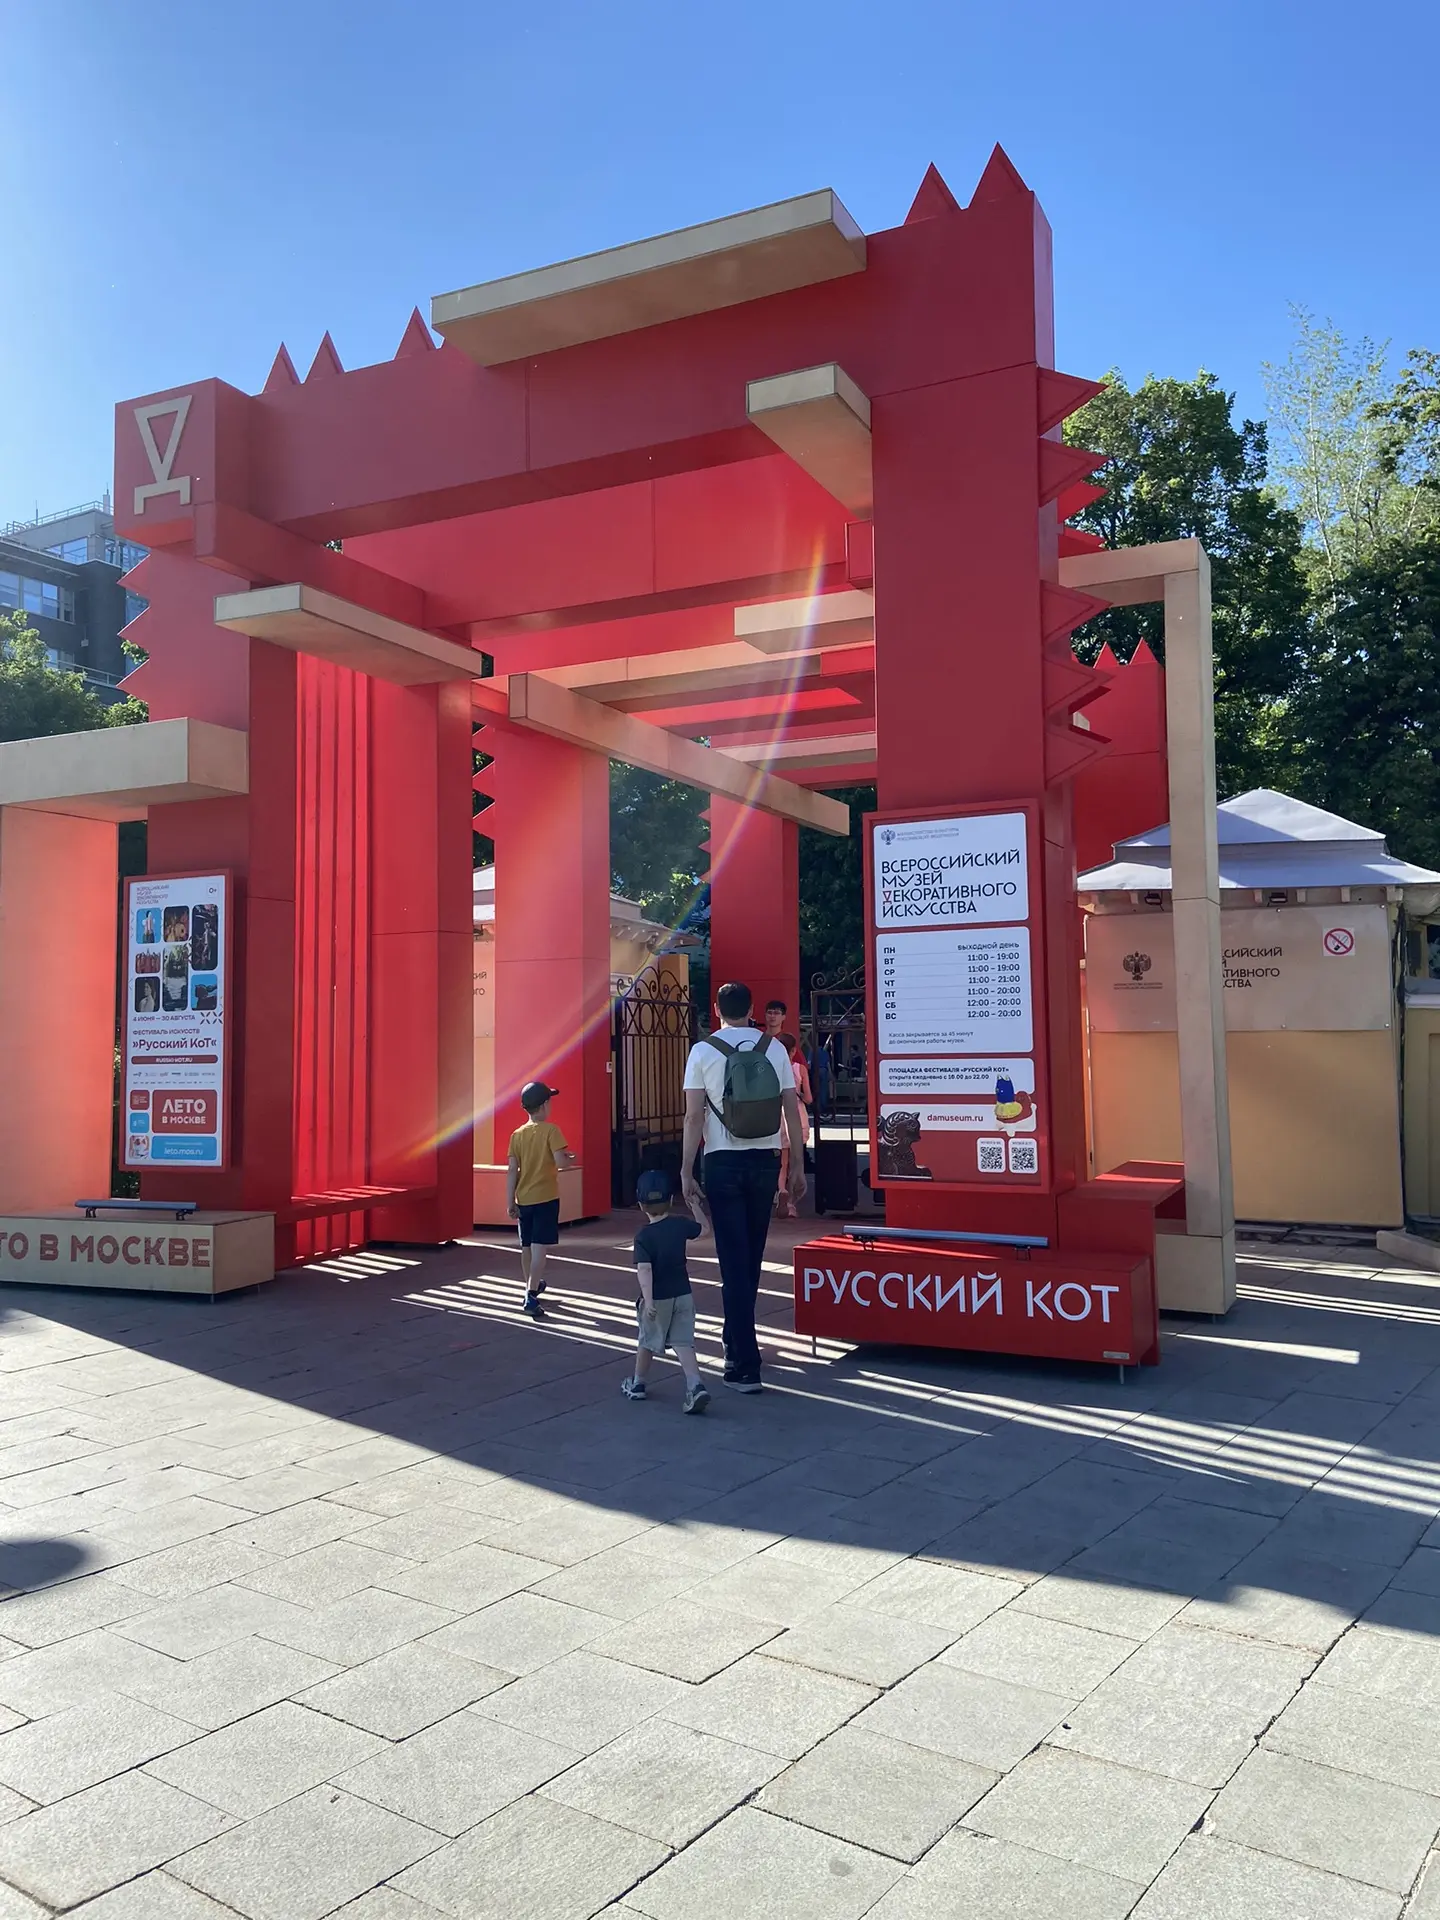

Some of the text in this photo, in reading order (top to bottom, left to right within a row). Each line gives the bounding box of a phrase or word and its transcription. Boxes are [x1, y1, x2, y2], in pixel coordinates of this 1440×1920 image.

[881, 848, 1020, 874] ВСЕРОССИЙСКИЙ
[882, 869, 943, 889] МУЗЕЙ
[882, 881, 1017, 905] ДЕКОРАТИВНОГО
[882, 900, 978, 918] ИСКУССТВА
[957, 942, 998, 951] выходной
[999, 942, 1020, 950] день
[967, 954, 989, 962] 11:00
[997, 952, 1020, 960] 19:00
[1222, 946, 1283, 959] СИЙСКИЙ
[967, 965, 989, 973] 11:00
[997, 963, 1020, 971] 19:00
[1222, 967, 1281, 978] ТИВНОГО
[968, 976, 990, 984] 11:00
[997, 975, 1021, 983] 21:00
[1223, 978, 1252, 989] СТВА
[997, 986, 1021, 994] 20:00
[967, 999, 990, 1007] 12:00
[997, 998, 1021, 1006] 20:00
[967, 1010, 990, 1018] 12:00
[997, 1009, 1022, 1017] 20:00
[132, 1037, 188, 1051] »Русский
[162, 1098, 207, 1114] ЛЕТО
[161, 1116, 207, 1124] В МОСКВЕ
[927, 1113, 984, 1122] damuseum.ru
[39, 1233, 59, 1261] В
[70, 1234, 211, 1268] МОСКВЕ
[803, 1267, 1120, 1323] РУССКИЙ КОТ
